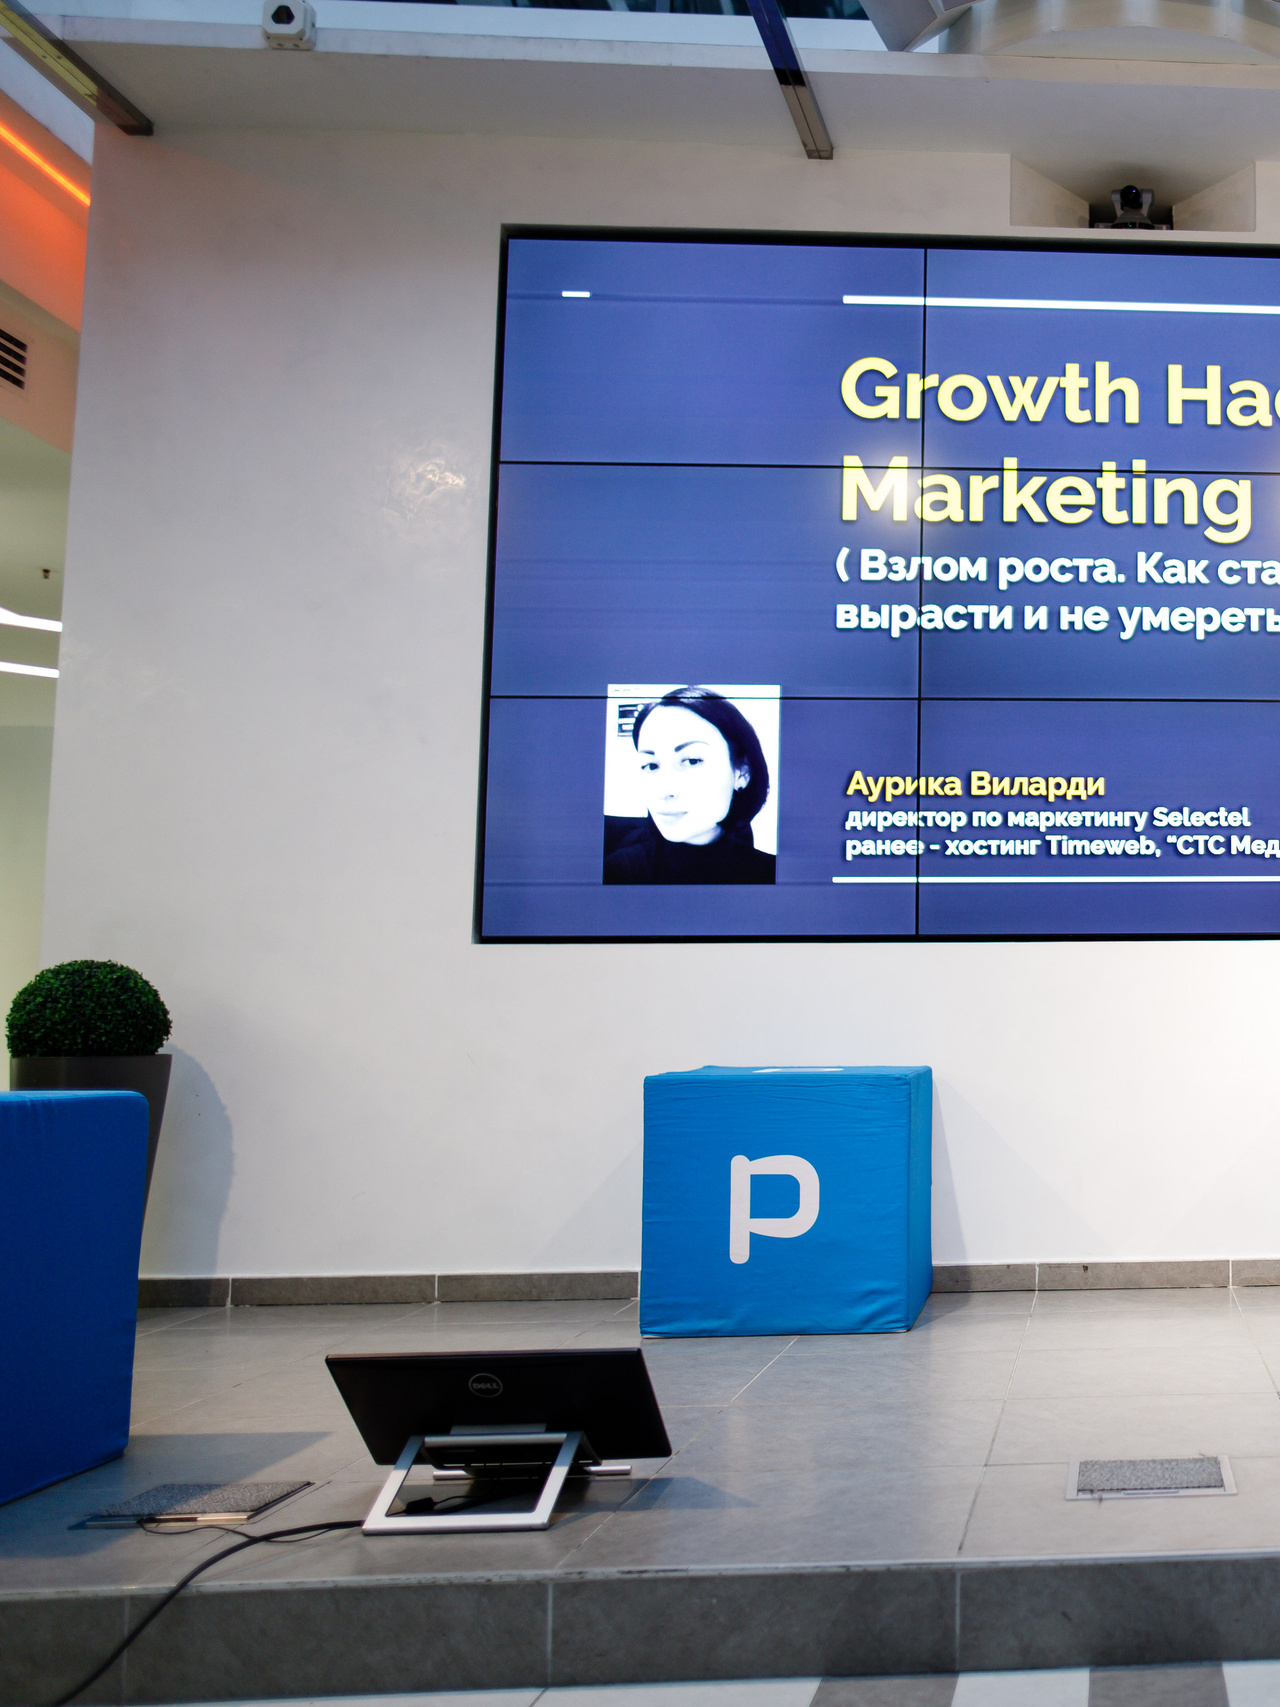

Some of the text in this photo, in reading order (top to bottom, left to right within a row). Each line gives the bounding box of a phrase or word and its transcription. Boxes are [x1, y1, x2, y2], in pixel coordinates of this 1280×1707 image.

[841, 357, 1139, 423] Growth
[842, 455, 1252, 543] Marketing
[861, 549, 986, 581] Взлом
[999, 557, 1125, 590] роста.
[1138, 552, 1210, 583] Как
[837, 604, 1012, 637] вырасти
[1025, 606, 1047, 629] и
[1060, 606, 1109, 630] не
[847, 771, 1105, 802] Аурика Виларди
[845, 807, 1251, 832] директор по маркетингу Selectel
[846, 840, 924, 860] ранее
[945, 840, 1041, 855] хостинг
[1045, 835, 1161, 857] Timeweb,
